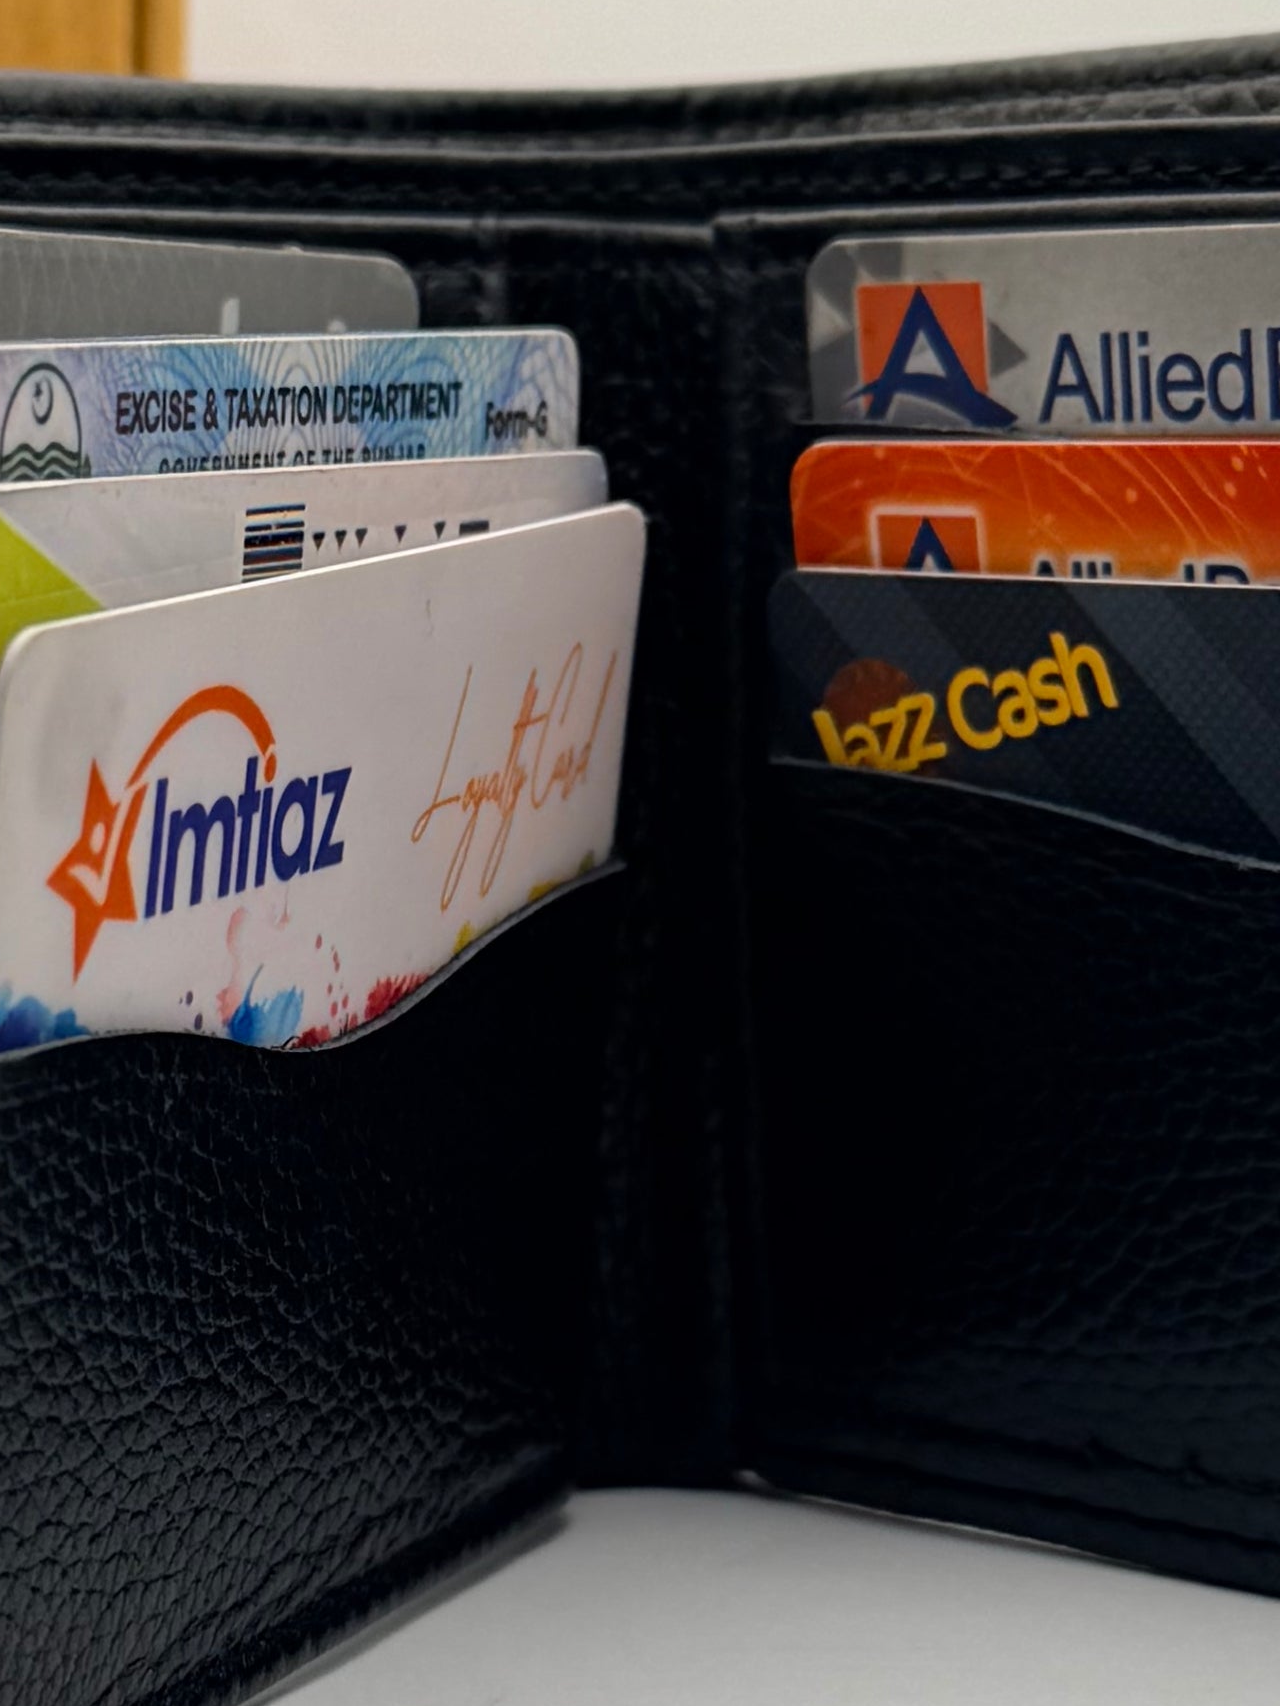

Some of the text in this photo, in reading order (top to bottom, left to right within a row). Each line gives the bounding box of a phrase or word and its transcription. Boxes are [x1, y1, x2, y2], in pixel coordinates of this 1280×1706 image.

[115, 381, 462, 435] EXCISE & TAXATION DEPARTMENT
[946, 631, 1119, 751] Cash
[143, 743, 354, 921] Imtiaz
